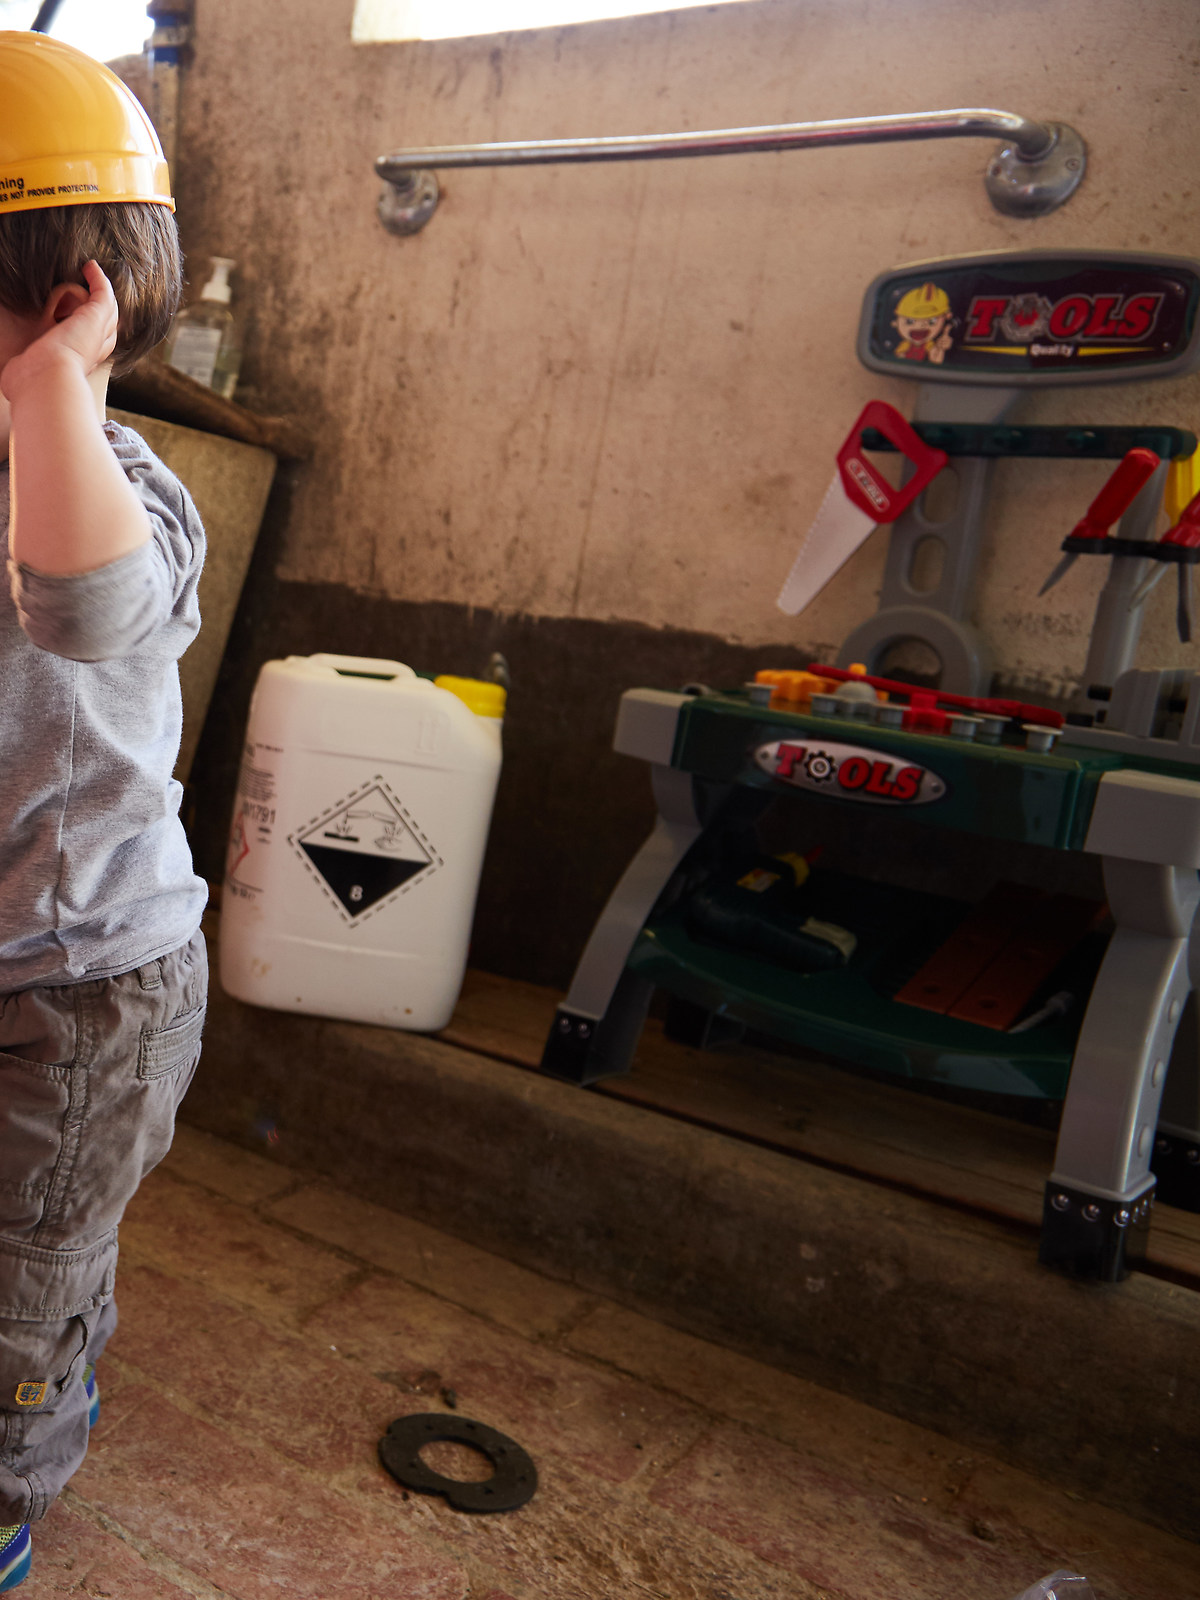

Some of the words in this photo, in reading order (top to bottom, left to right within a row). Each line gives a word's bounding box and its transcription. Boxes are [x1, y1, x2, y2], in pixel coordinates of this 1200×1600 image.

[10, 190, 25, 201] NOT
[27, 187, 56, 197] PROVIDE
[1030, 344, 1075, 358] Quality
[350, 885, 363, 901] 8
